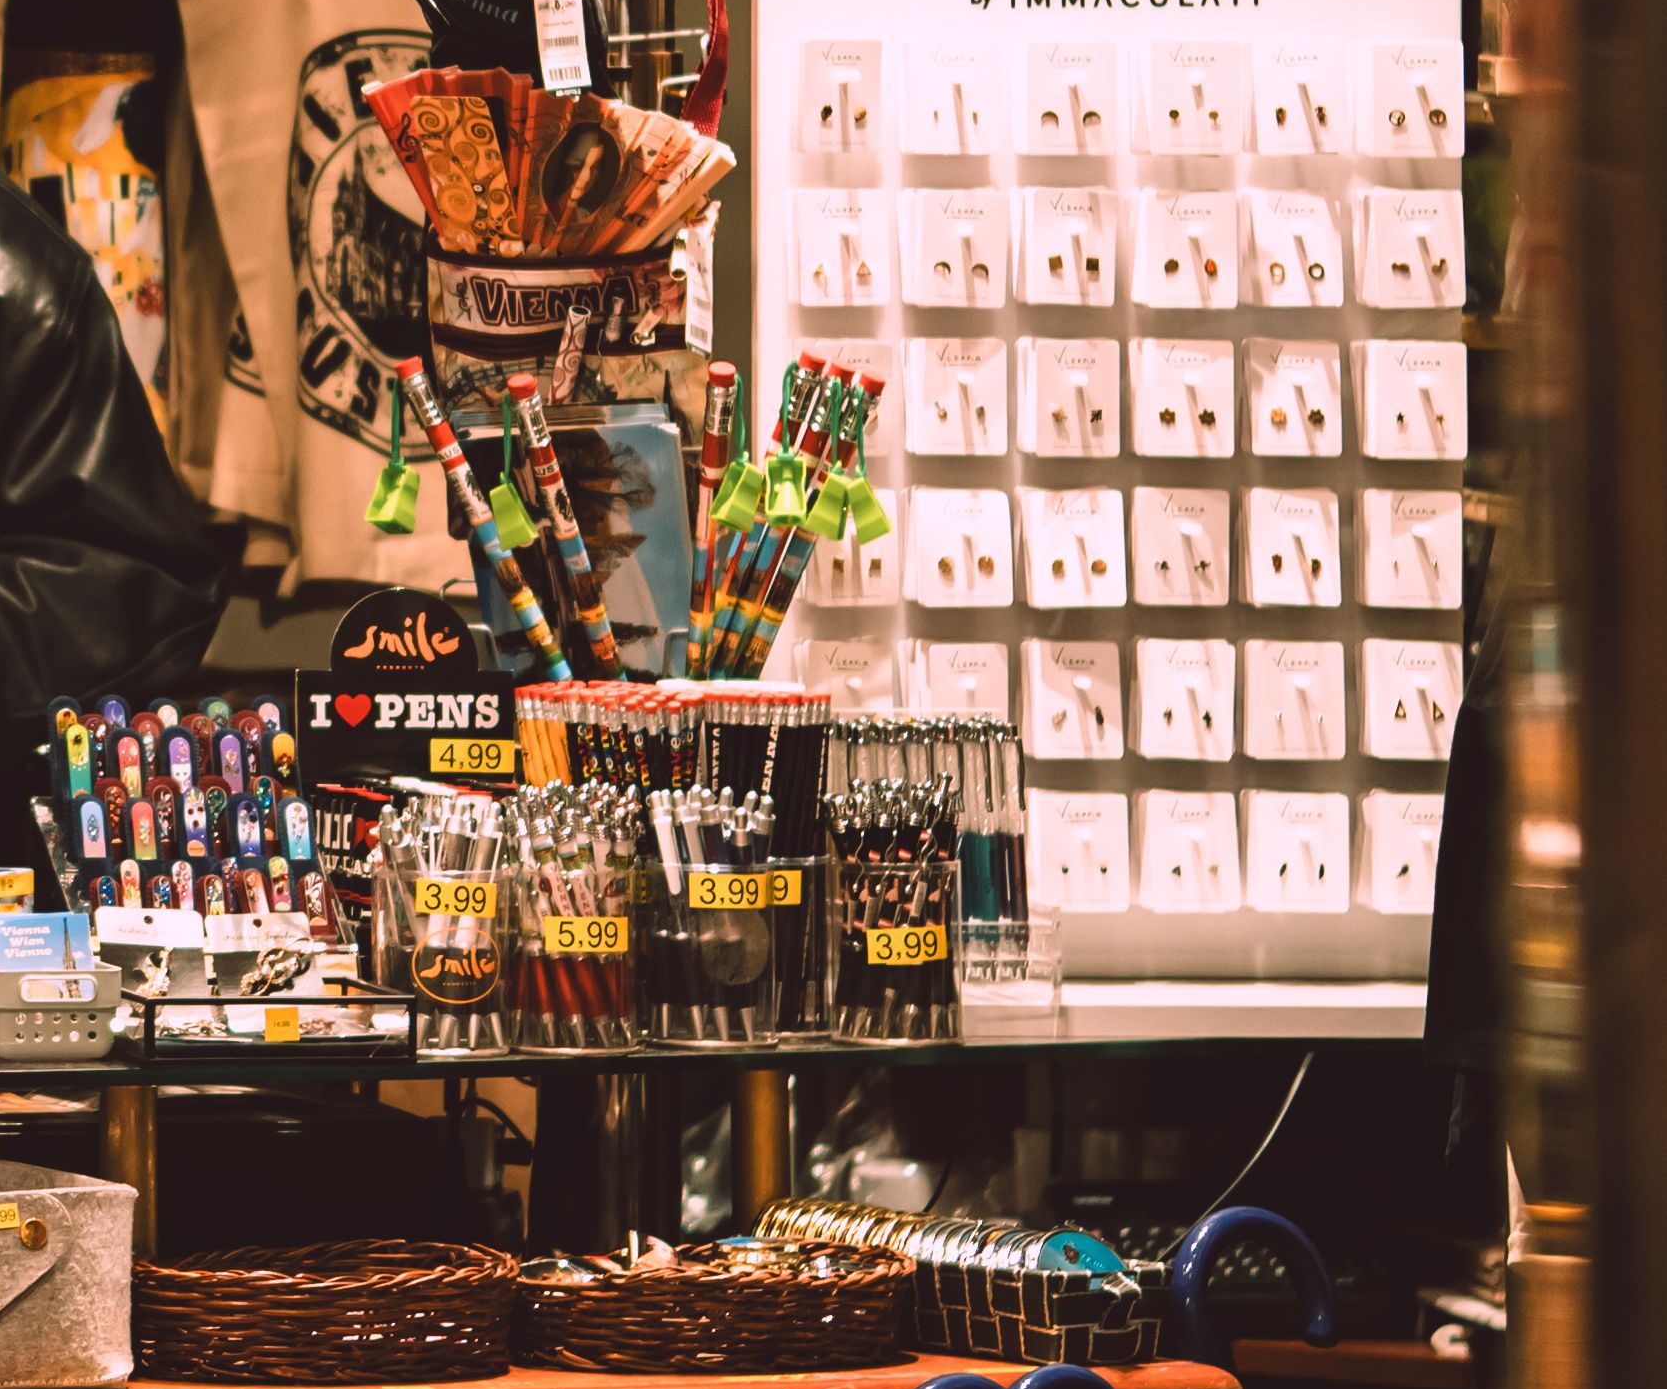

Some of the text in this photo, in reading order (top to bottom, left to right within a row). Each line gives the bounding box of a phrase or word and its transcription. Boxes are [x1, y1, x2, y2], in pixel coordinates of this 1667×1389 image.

[471, 274, 641, 327] VIENNA
[310, 694, 501, 729] I PENS
[439, 743, 502, 771] 4,99
[425, 883, 487, 913] 3,99
[699, 877, 760, 905] 3,99
[1, 925, 52, 936] Vienna
[8, 937, 46, 947] Wien
[558, 921, 620, 949] 5,99
[876, 930, 939, 961] 3,99
